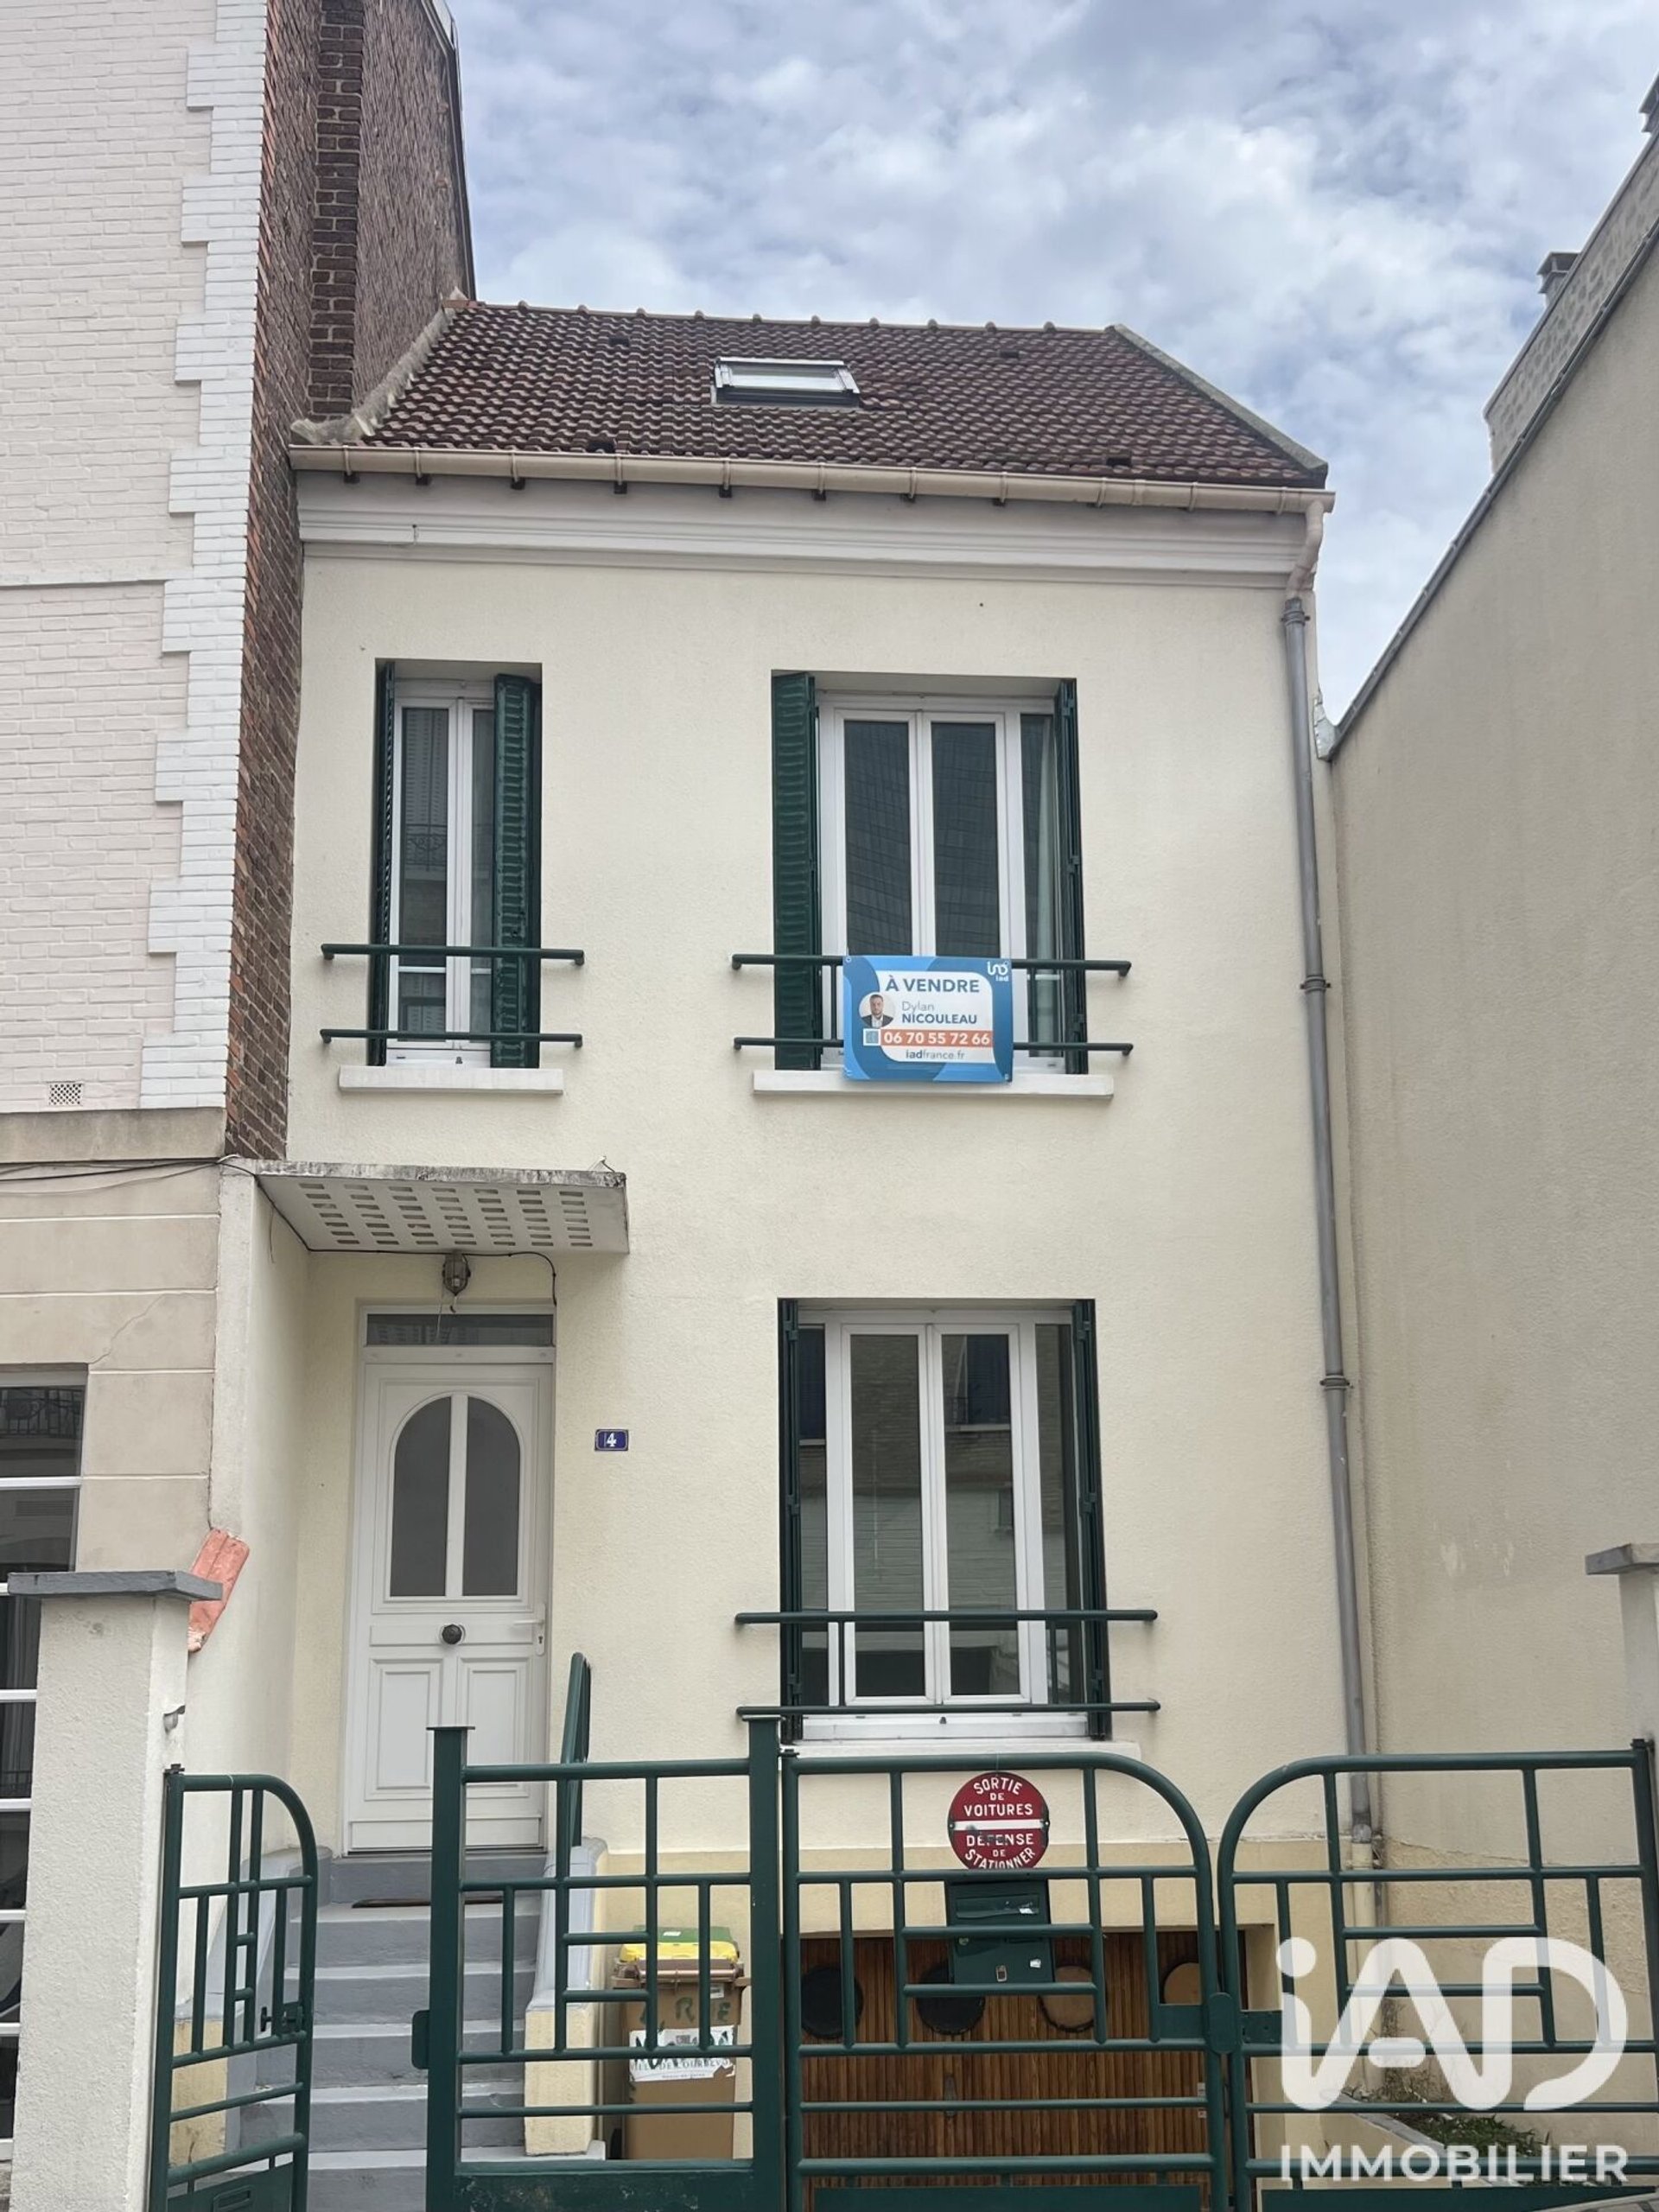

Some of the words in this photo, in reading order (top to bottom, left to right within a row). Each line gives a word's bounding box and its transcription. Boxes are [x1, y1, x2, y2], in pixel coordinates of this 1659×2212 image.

[885, 975, 899, 992] À
[903, 978, 980, 993] VENDRE
[901, 1001, 935, 1014] Dylan
[901, 1014, 977, 1024] NICOULEAU
[883, 1032, 902, 1044] 06
[906, 1032, 925, 1044] 70
[928, 1033, 946, 1044] 55
[950, 1033, 969, 1045] 72
[971, 1033, 990, 1045] 66
[906, 1049, 966, 1059] iadfrance.fr
[973, 1777, 1023, 1796] SORTIE
[989, 1792, 1005, 1801] DE
[963, 1803, 1033, 1817] VOITURES
[964, 1847, 1036, 1868] STATIONNER
